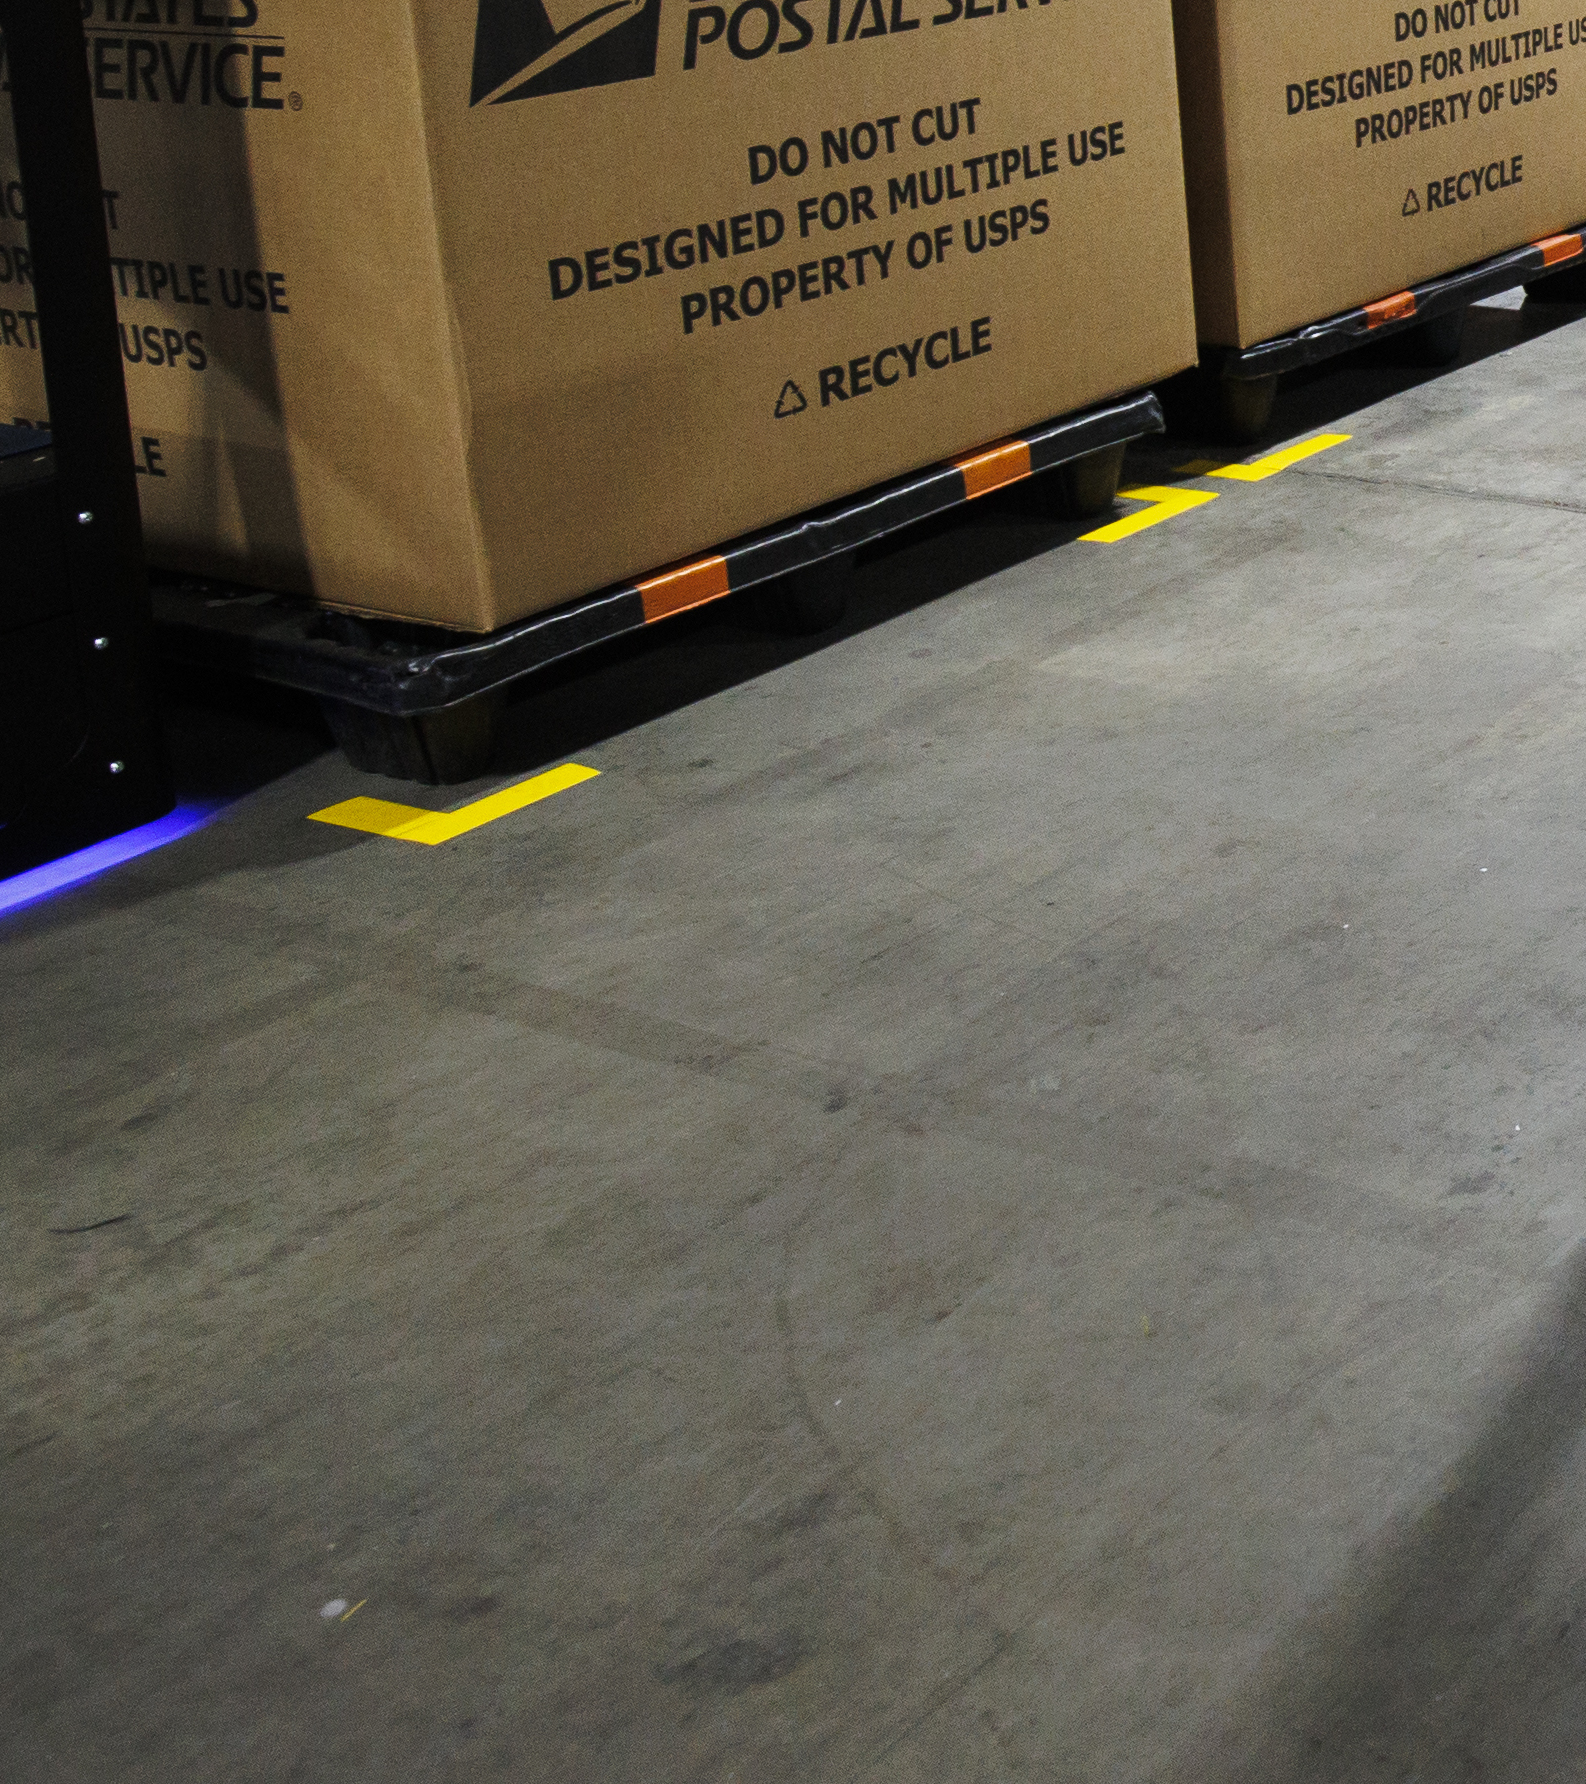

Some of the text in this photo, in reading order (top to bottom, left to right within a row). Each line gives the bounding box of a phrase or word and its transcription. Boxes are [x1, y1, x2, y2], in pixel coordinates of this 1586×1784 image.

[1285, 59, 1414, 116] DESIGNED
[1420, 47, 1464, 84] FOR
[1469, 22, 1564, 72] MULTIPLE
[1394, 8, 1428, 43] DO
[747, 97, 982, 186] DO NOT CUT
[1355, 68, 1558, 148] PROPERTY OF USPS
[547, 120, 1126, 301] DESIGNED FOR MULTIPLE USE
[1426, 154, 1523, 212] RECYCLE
[218, 267, 290, 315] USE
[680, 198, 1051, 335] PROPERTY OF USPS
[817, 315, 993, 408] RECYCLE
